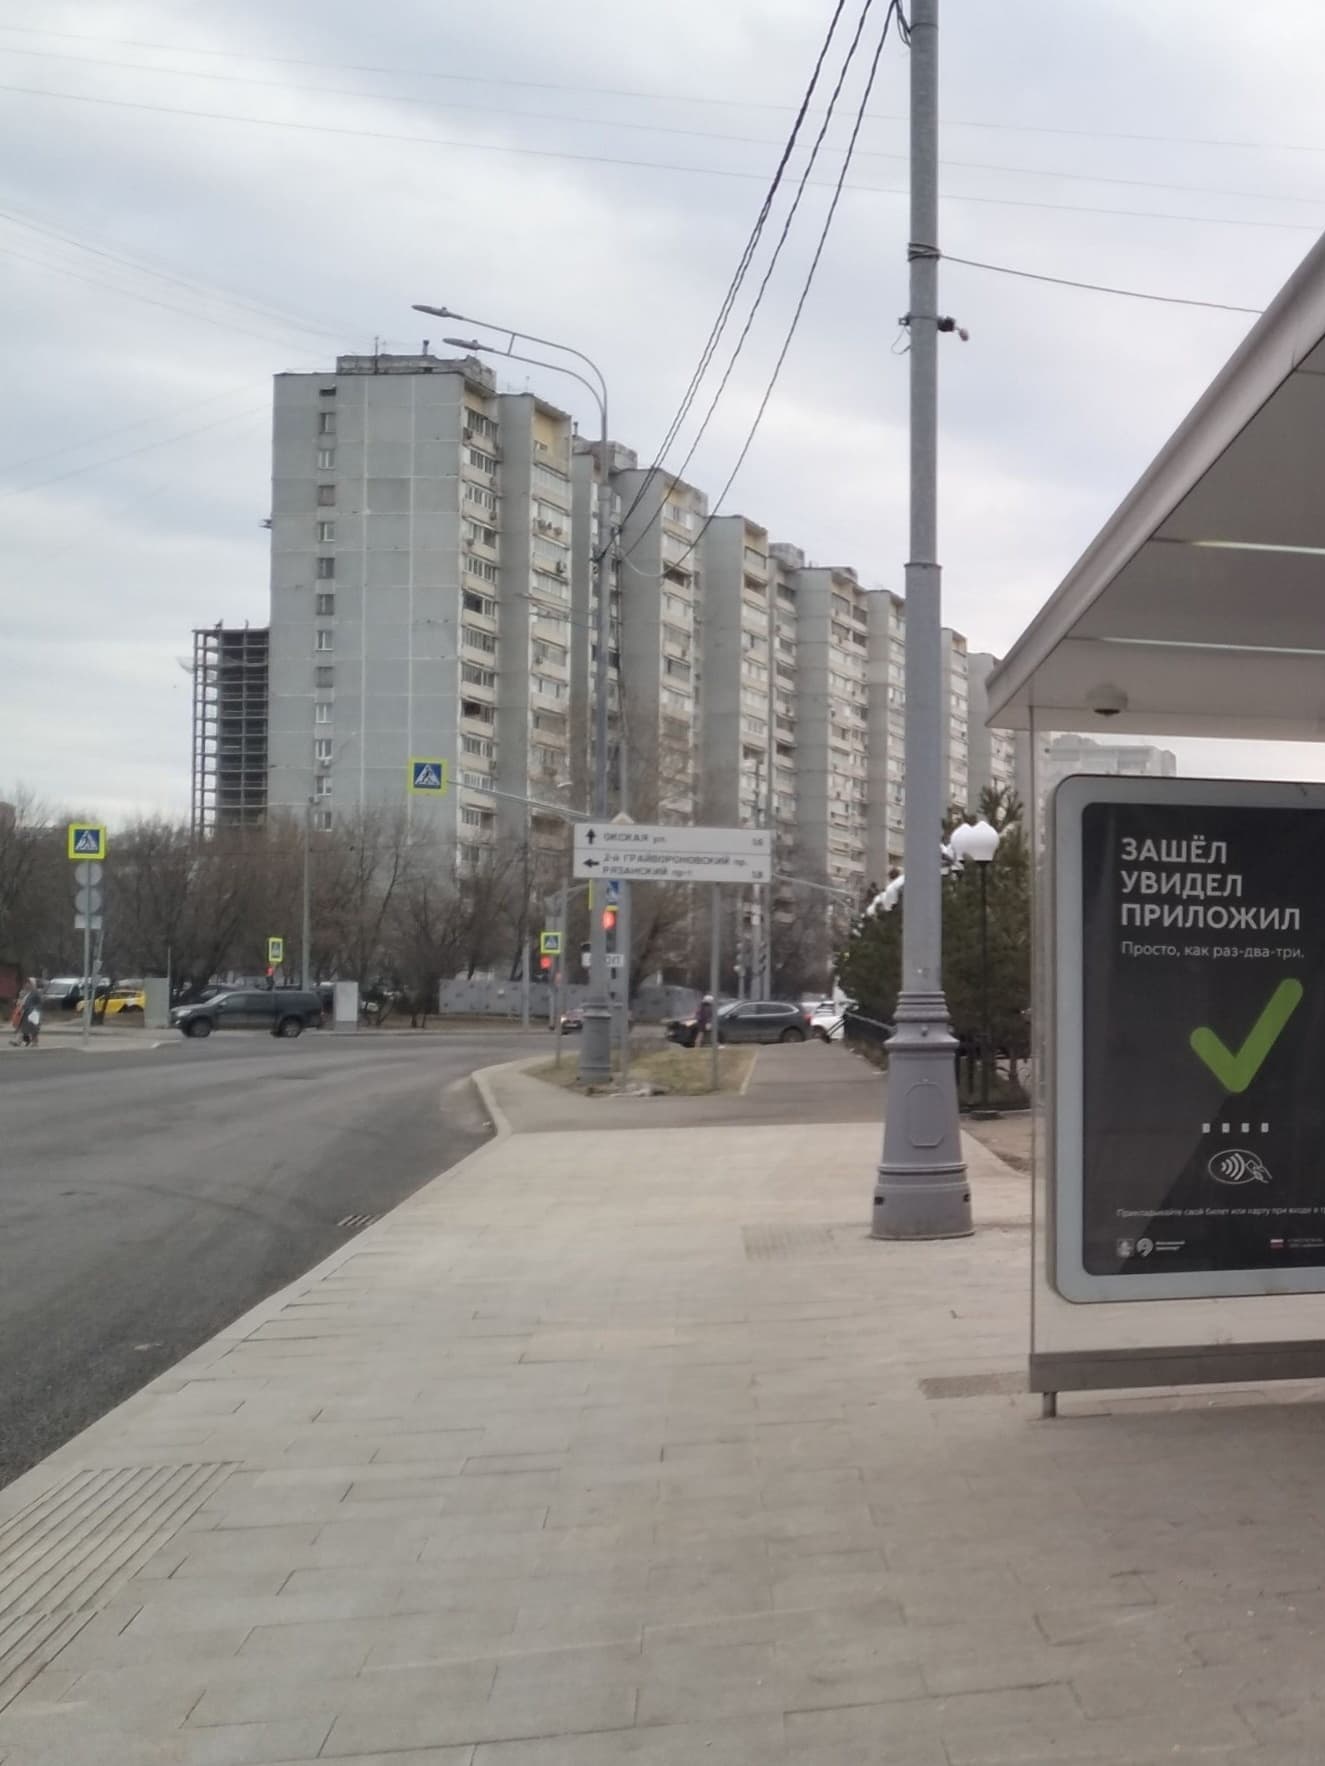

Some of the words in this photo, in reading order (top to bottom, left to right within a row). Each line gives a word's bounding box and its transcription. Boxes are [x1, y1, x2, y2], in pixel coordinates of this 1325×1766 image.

[603, 832, 649, 843] ОКСКАЯ
[1121, 834, 1227, 865] ЗАШЁЛ
[1120, 870, 1243, 900] УВИДЕЛ
[1121, 903, 1301, 931] ПРИЛОЖИЛ
[1121, 941, 1181, 958] Просто,
[1184, 945, 1209, 958] как
[1213, 945, 1305, 961] раз-два-три.
